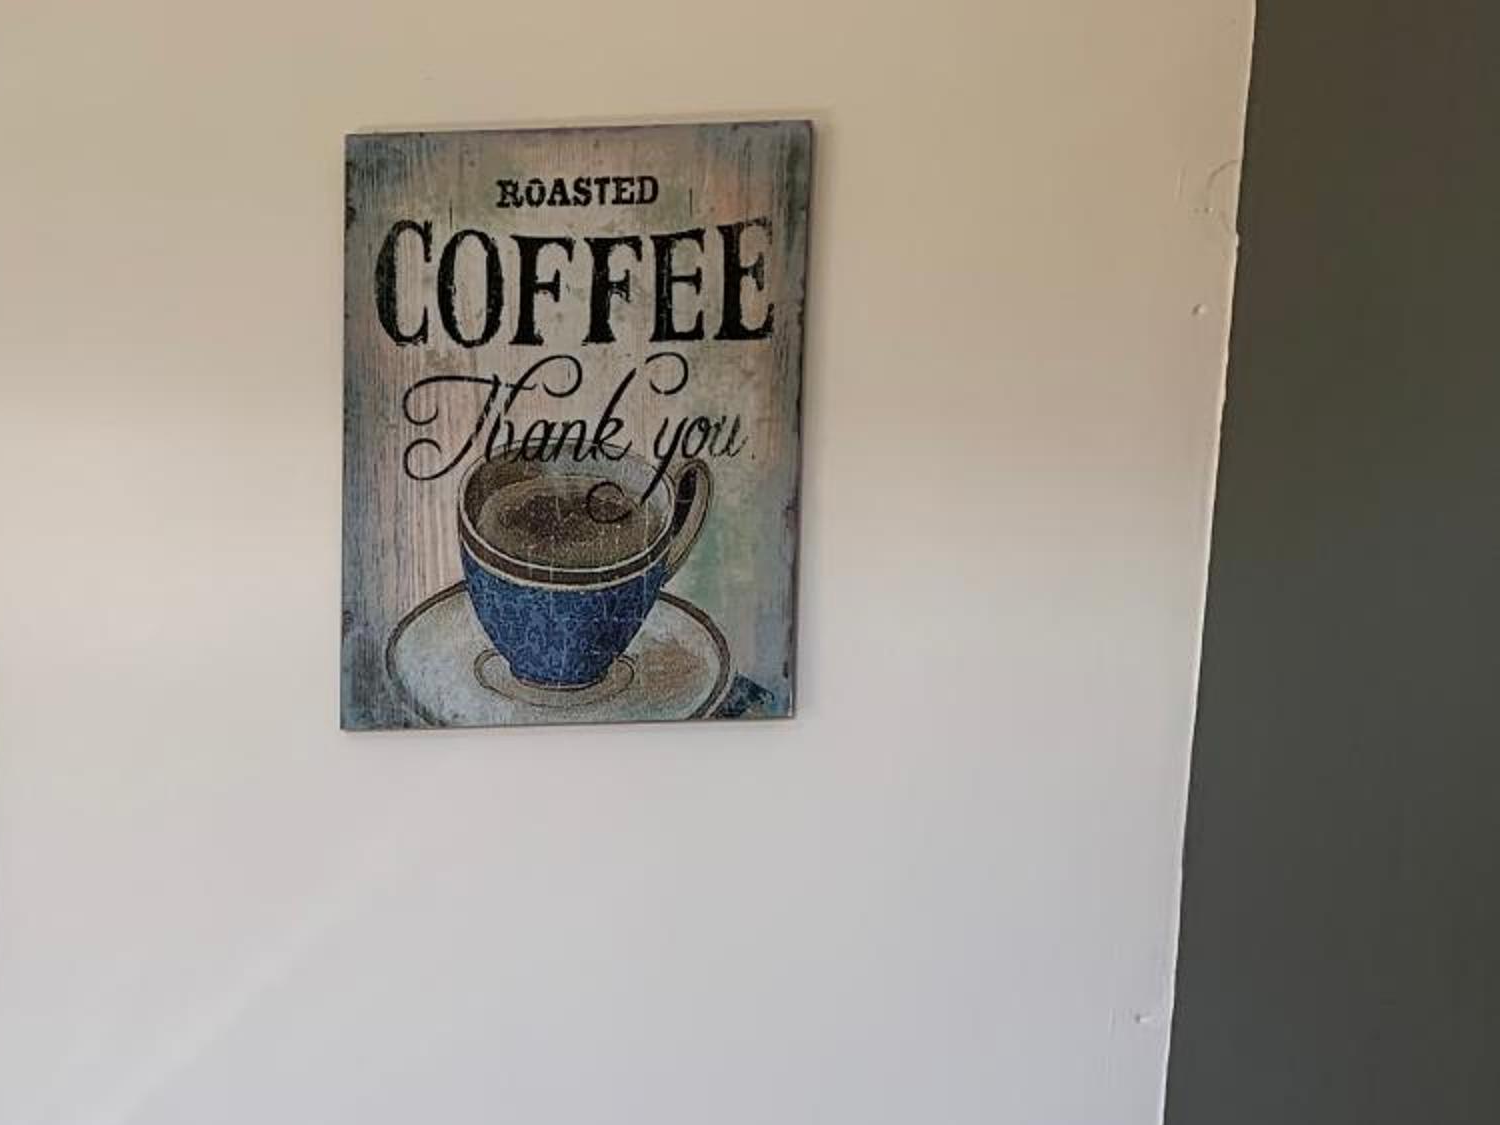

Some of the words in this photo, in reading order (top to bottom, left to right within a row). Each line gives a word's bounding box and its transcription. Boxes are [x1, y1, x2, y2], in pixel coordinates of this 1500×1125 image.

[496, 175, 660, 208] ROASTED
[374, 216, 774, 349] COFFEE
[401, 352, 690, 482] Thank
